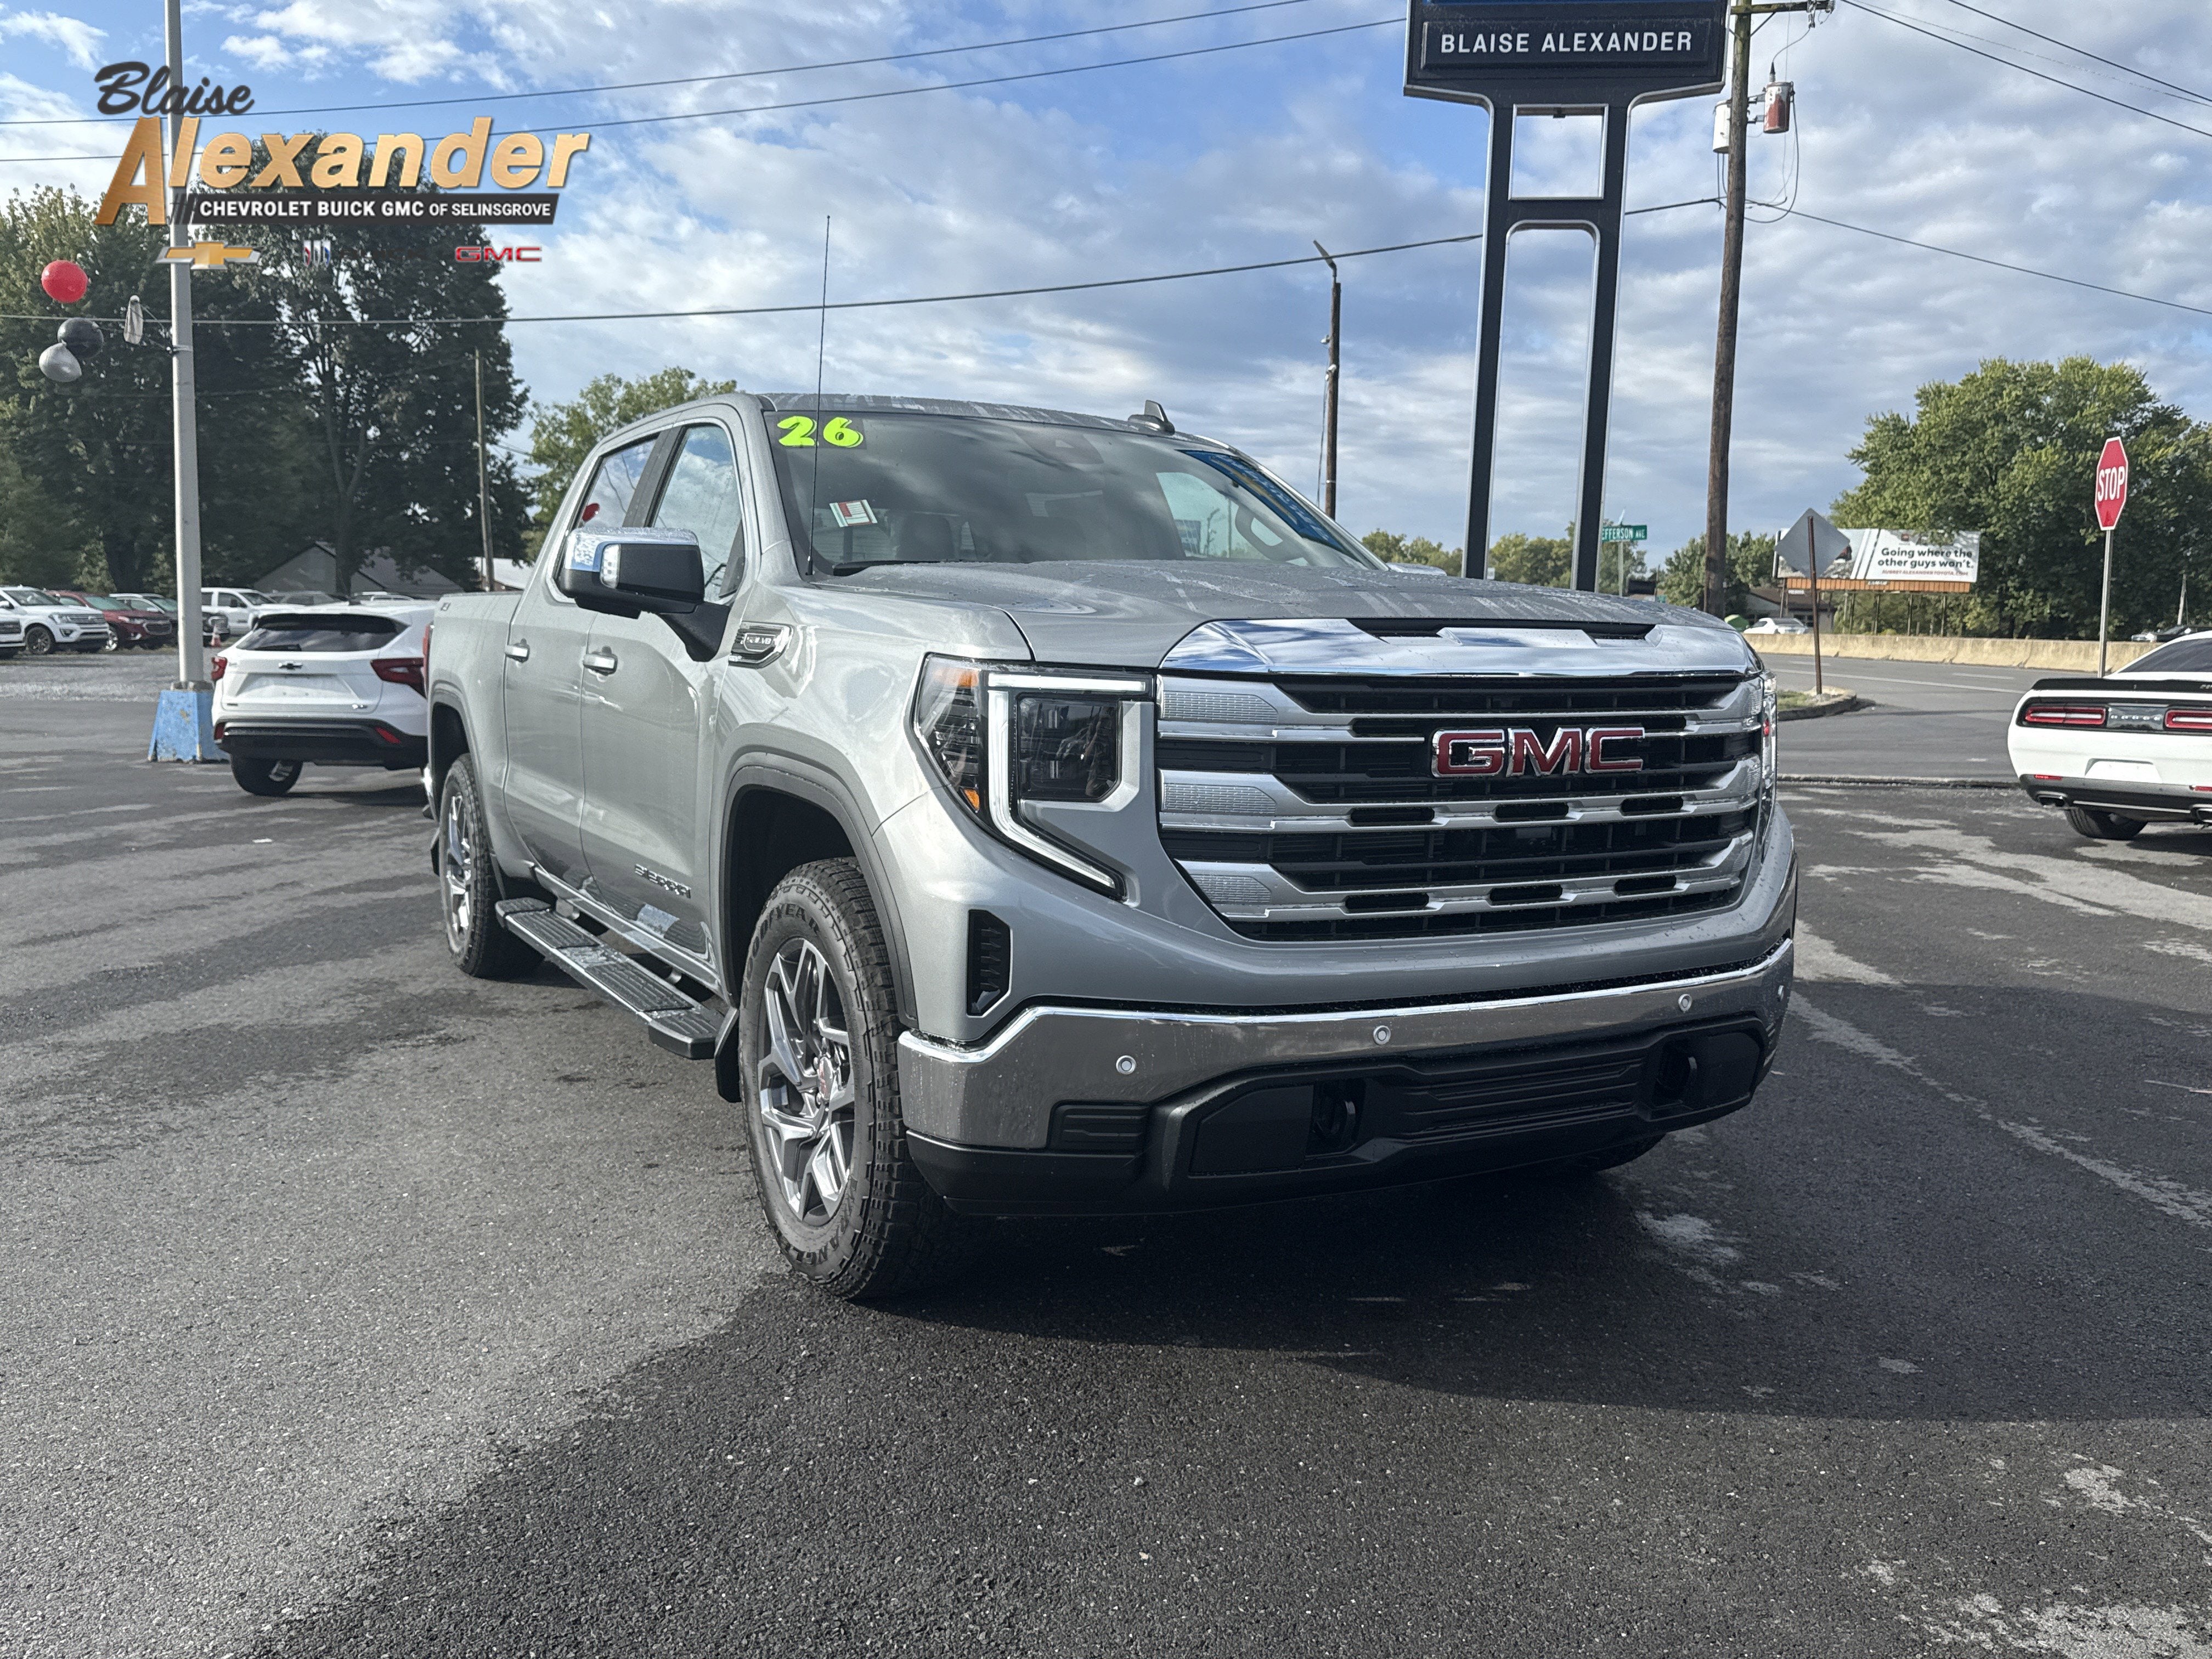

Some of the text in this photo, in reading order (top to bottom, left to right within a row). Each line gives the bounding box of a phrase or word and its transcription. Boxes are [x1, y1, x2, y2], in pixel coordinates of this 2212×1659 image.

[1441, 31, 1692, 53] BLAISE ALEXANDER
[777, 415, 864, 448] 26
[2097, 466, 2125, 502] STOP
[1602, 527, 1633, 540] EFFERSON
[1878, 557, 1907, 567] other
[1910, 560, 1936, 569] guys
[1882, 548, 1972, 558] Going where the
[1431, 727, 1645, 778] GMC
